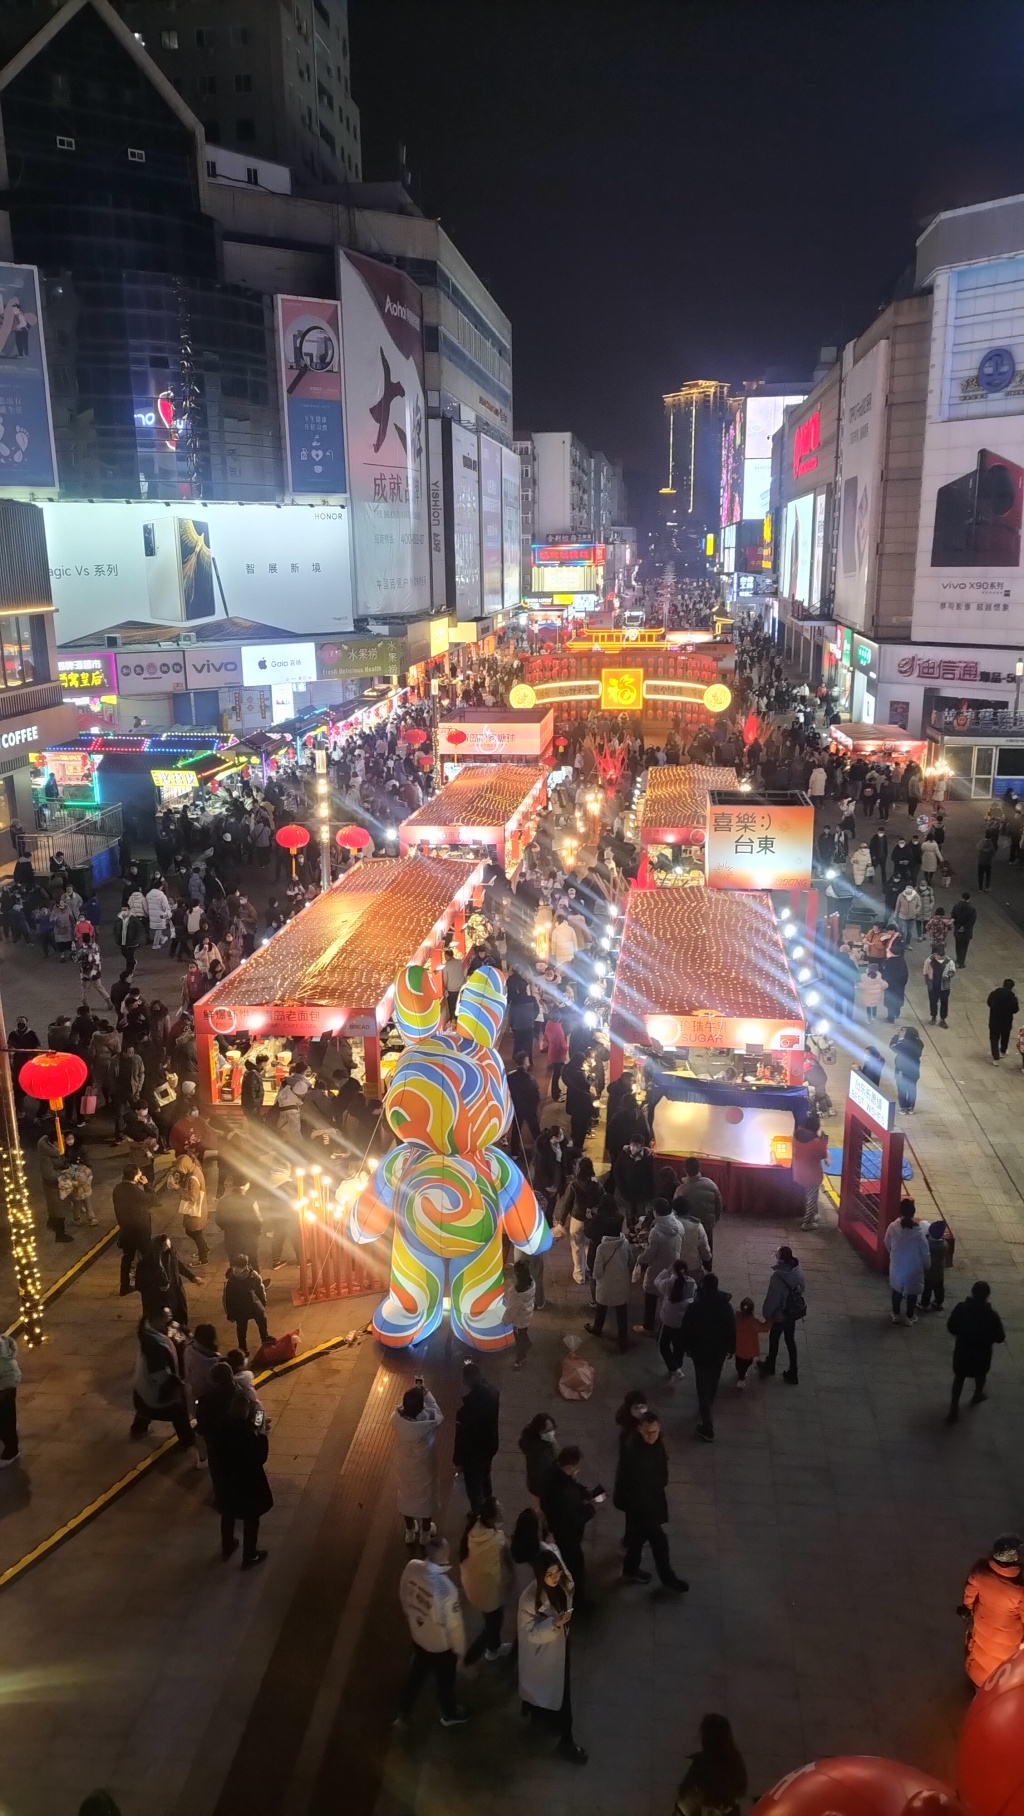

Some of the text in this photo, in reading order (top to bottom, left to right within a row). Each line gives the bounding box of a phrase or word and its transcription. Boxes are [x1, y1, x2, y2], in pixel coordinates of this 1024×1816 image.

[75, 565, 90, 576] Vs
[93, 564, 119, 577] 系列
[245, 562, 322, 574] 智展新境
[941, 581, 967, 590] vivo
[192, 659, 238, 673] vivo
[1, 725, 39, 748] COFFEE
[734, 834, 776, 855] 台東
[681, 1033, 724, 1044] SUGAR
